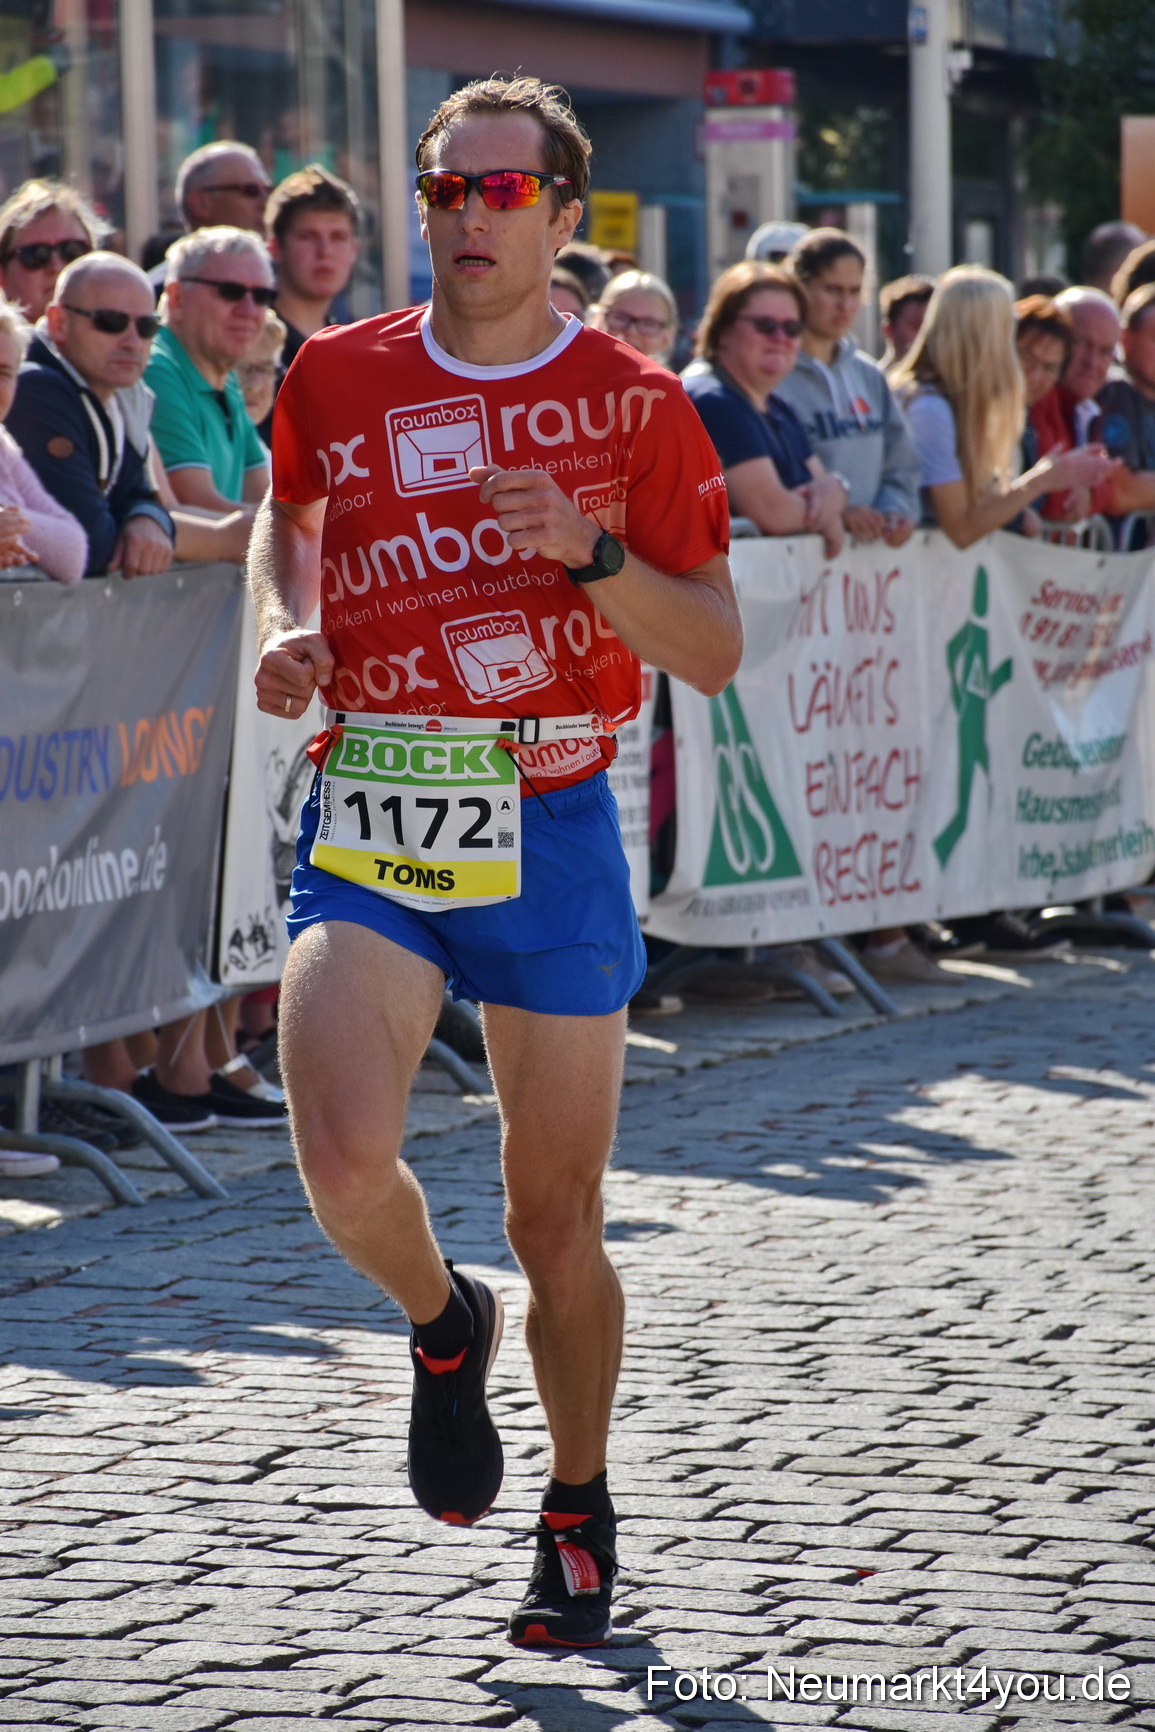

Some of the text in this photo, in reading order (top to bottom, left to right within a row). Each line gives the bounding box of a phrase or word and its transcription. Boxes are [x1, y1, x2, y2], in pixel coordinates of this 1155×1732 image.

[393, 405, 479, 432] raumbox
[386, 585, 469, 616] wohnen
[482, 567, 561, 597] outdoor
[338, 734, 497, 780] BOCK
[343, 790, 494, 850] 1172
[500, 800, 511, 811] A
[373, 858, 456, 892] TOMS
